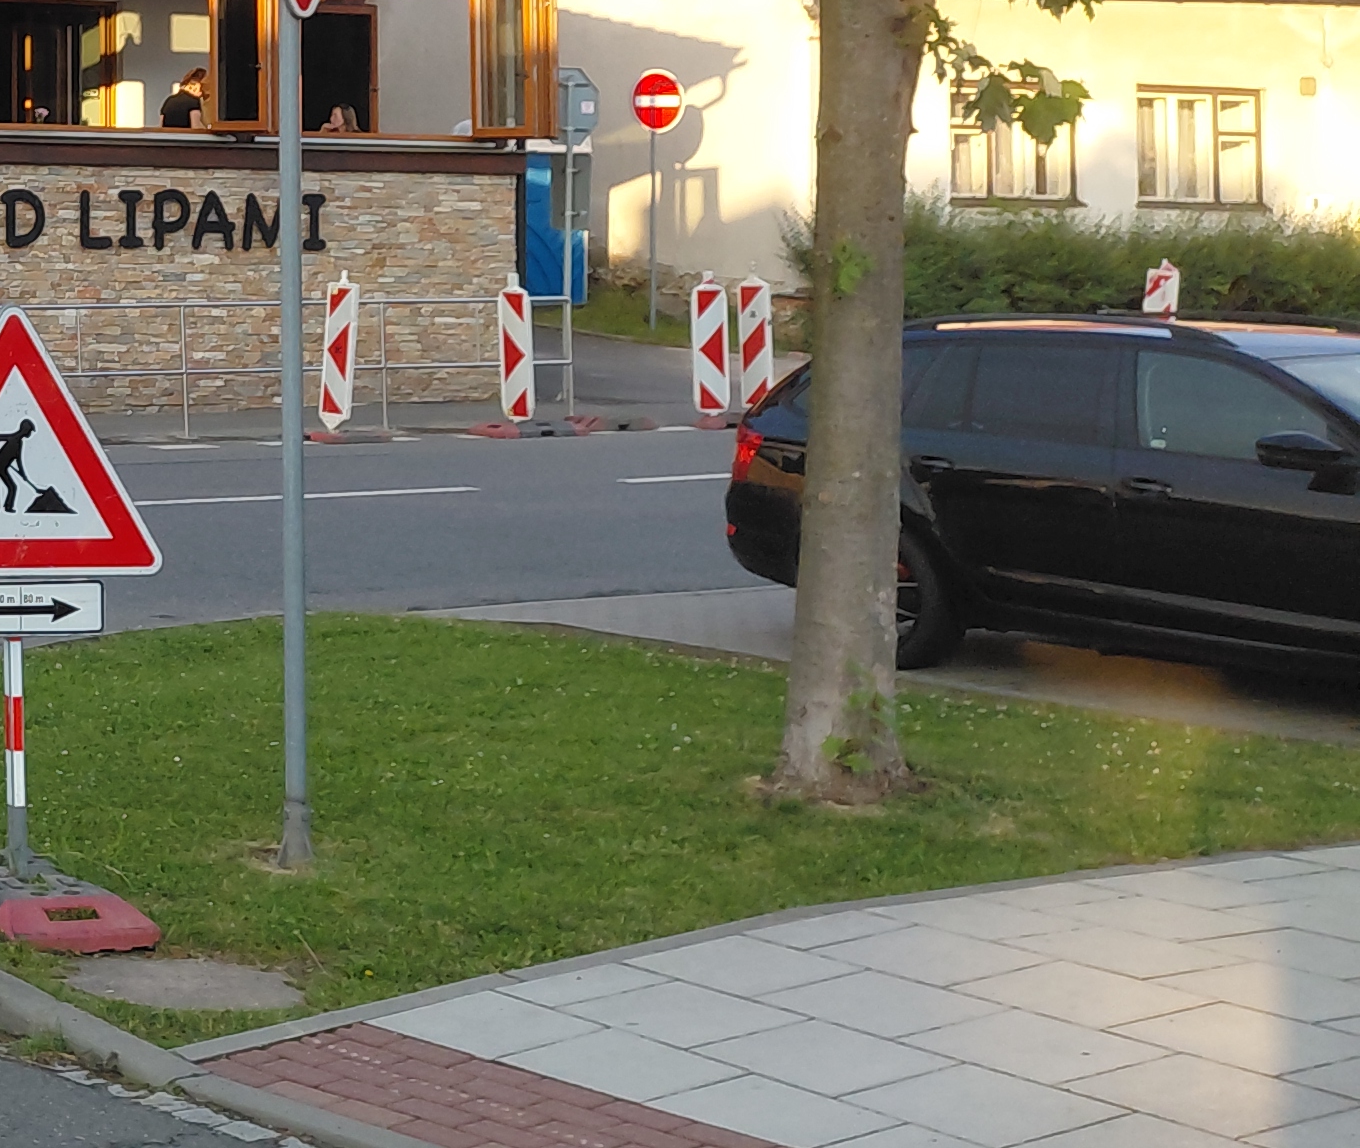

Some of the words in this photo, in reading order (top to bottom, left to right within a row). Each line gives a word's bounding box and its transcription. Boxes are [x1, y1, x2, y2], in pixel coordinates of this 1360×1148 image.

[78, 188, 328, 253] LIPAMI
[6, 596, 16, 604] m
[35, 595, 44, 603] m
